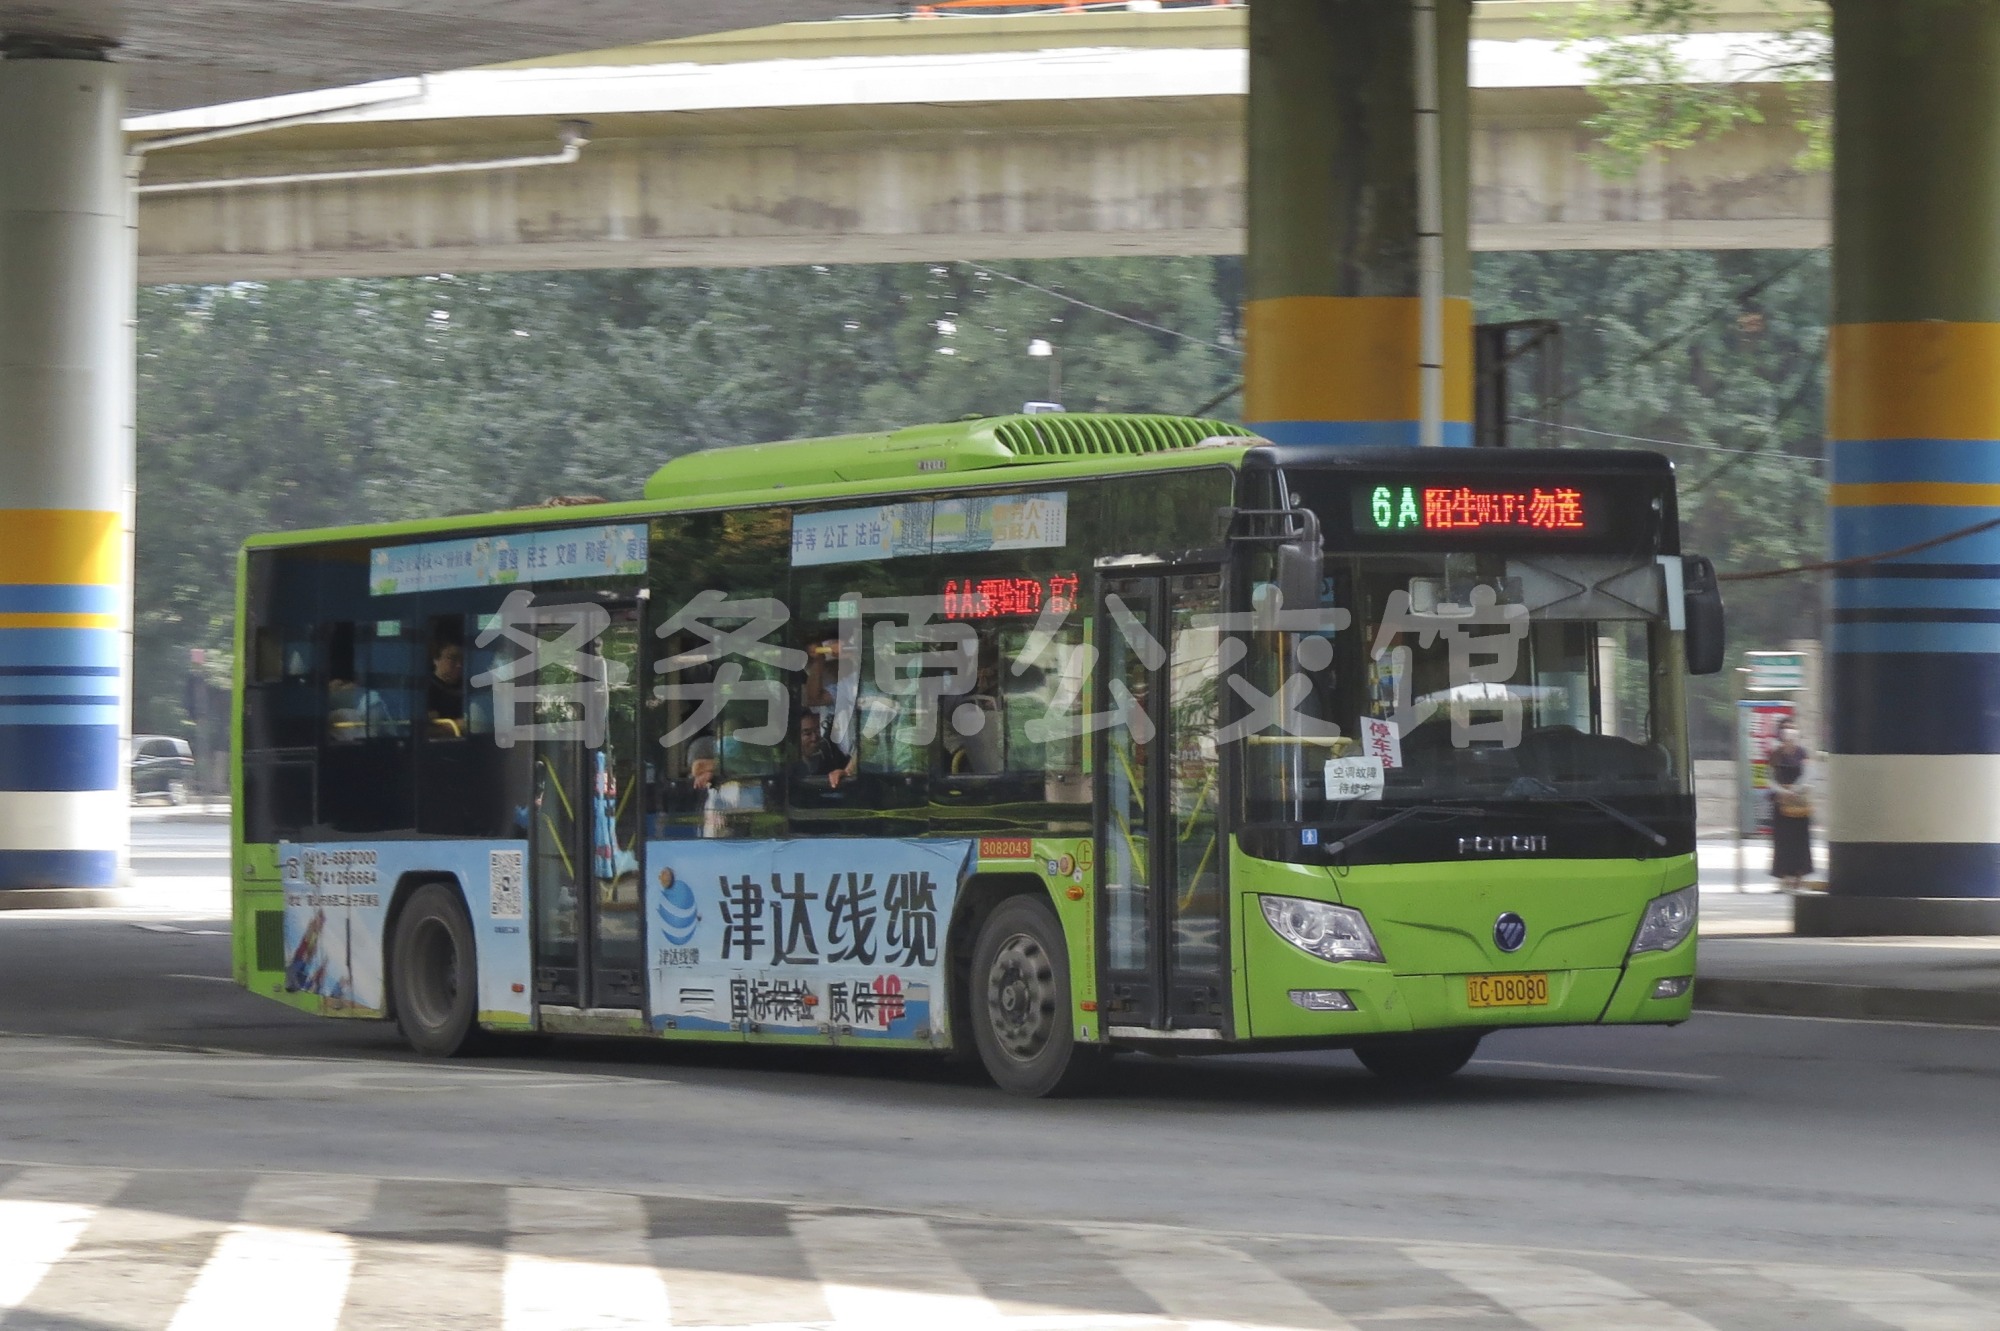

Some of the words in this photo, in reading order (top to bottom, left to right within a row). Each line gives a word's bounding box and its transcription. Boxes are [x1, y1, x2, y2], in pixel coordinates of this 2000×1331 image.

[824, 525, 848, 548] 公正
[856, 521, 880, 546] 法治
[1333, 766, 1378, 780] 空调故障
[718, 871, 938, 968] 津达线缆
[658, 949, 699, 966] 津达线缆
